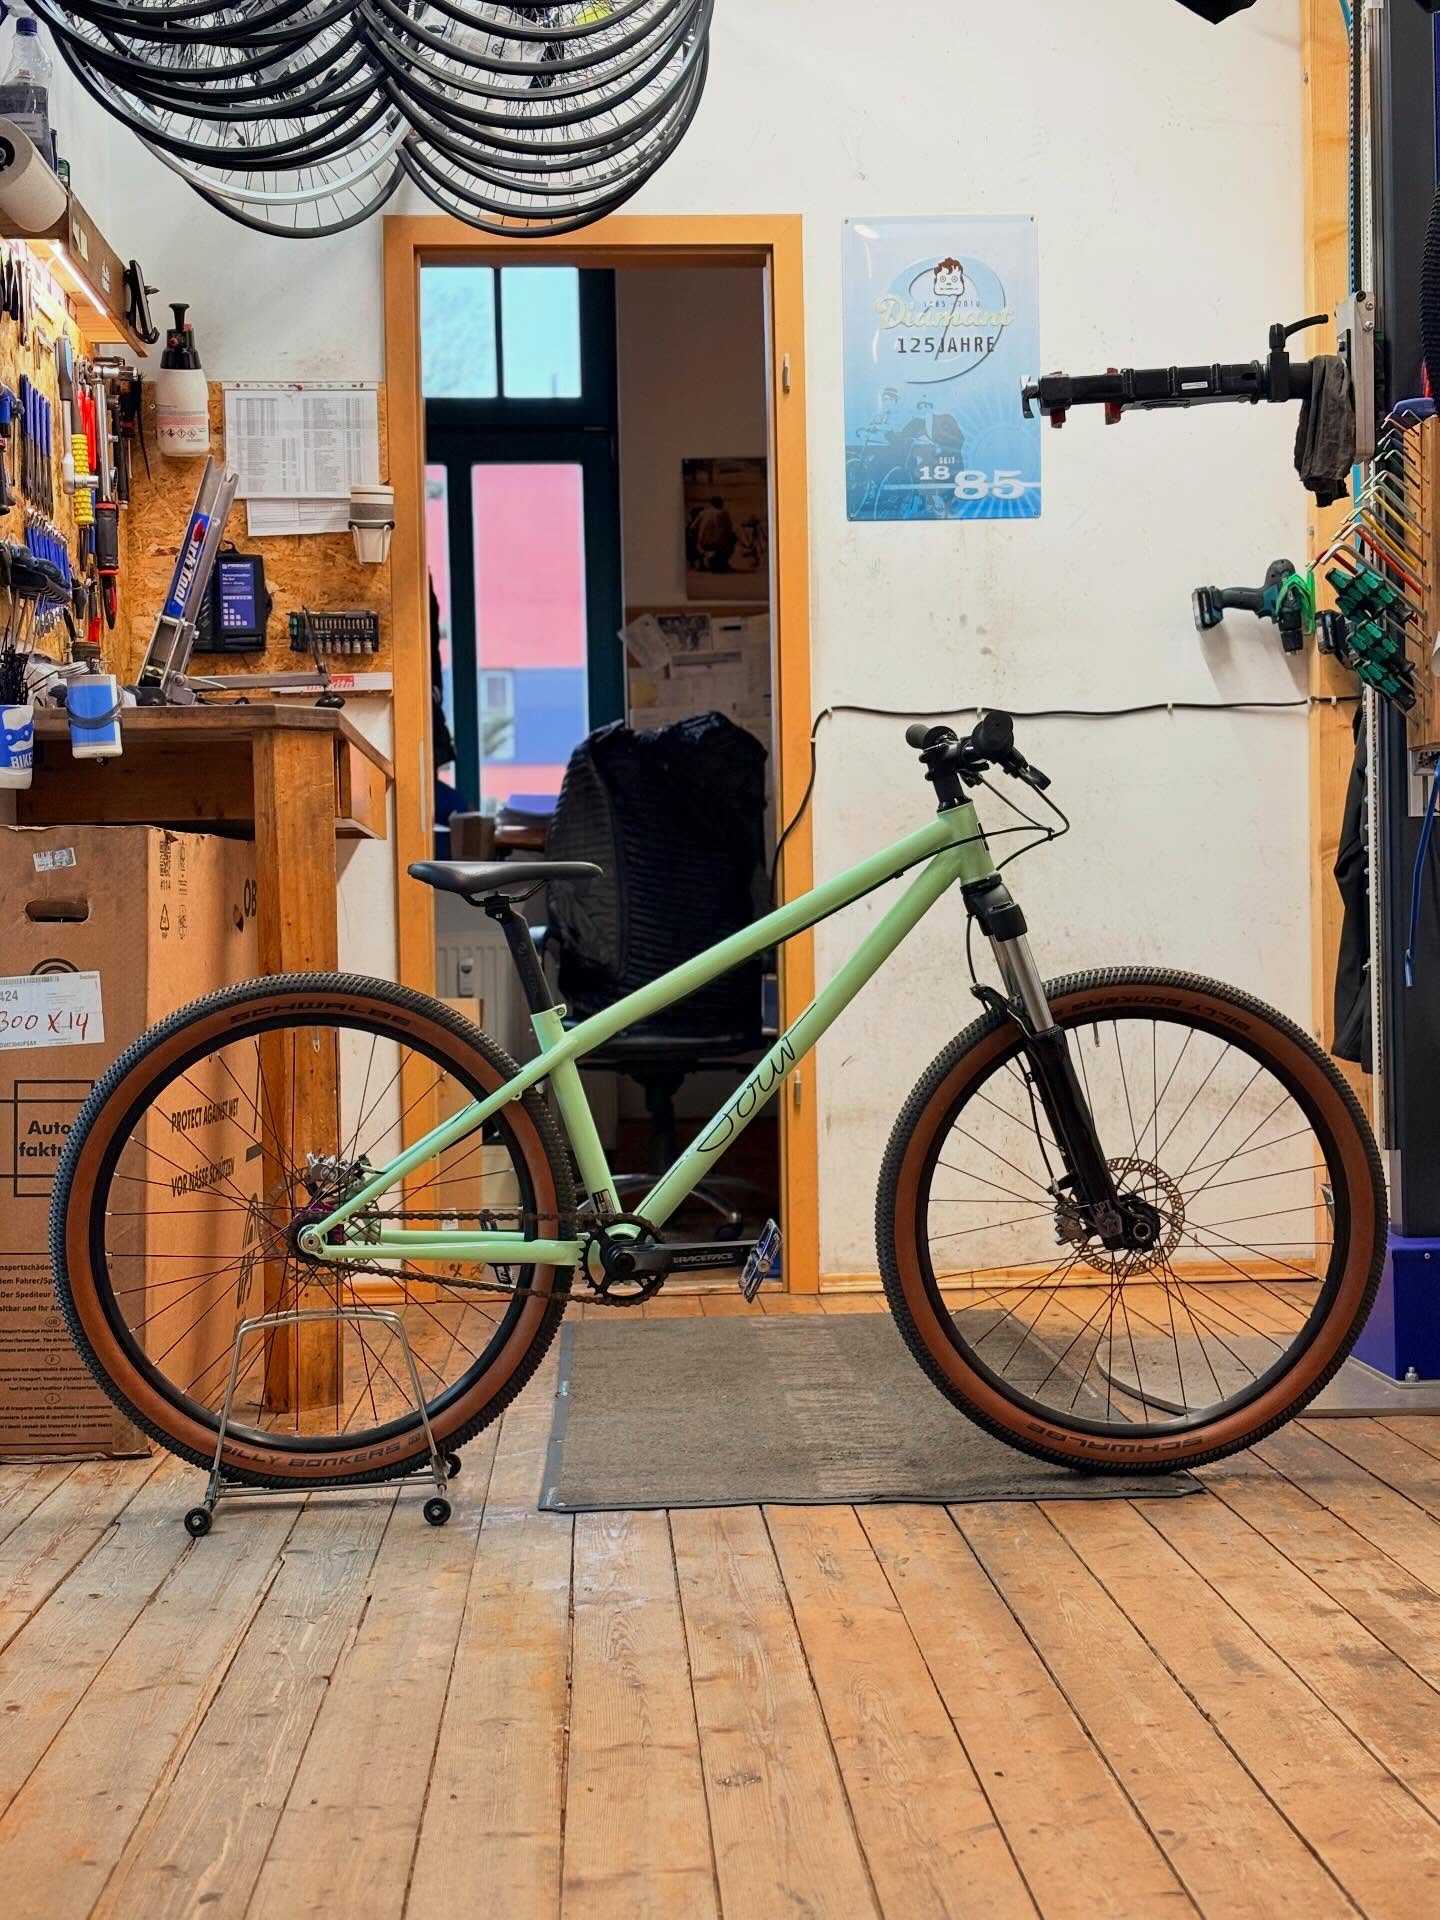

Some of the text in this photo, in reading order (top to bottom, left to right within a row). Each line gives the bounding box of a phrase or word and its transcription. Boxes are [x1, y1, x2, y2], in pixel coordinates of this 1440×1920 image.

[875, 296, 1013, 329] Diamant
[898, 336, 994, 353] 125 JAHRE
[919, 465, 1025, 500] 18 85
[10, 752, 33, 769] BIKE
[70, 1012, 88, 1041] 14
[230, 1002, 411, 1026] SCHWALBE
[171, 1097, 239, 1133] PROTECT AGAINST WET
[171, 1155, 234, 1198] VOR NÄSSE SCHÜTZEN
[1026, 1422, 1204, 1453] SCHWALBE
[222, 1442, 401, 1467] BILLY BONKERS
